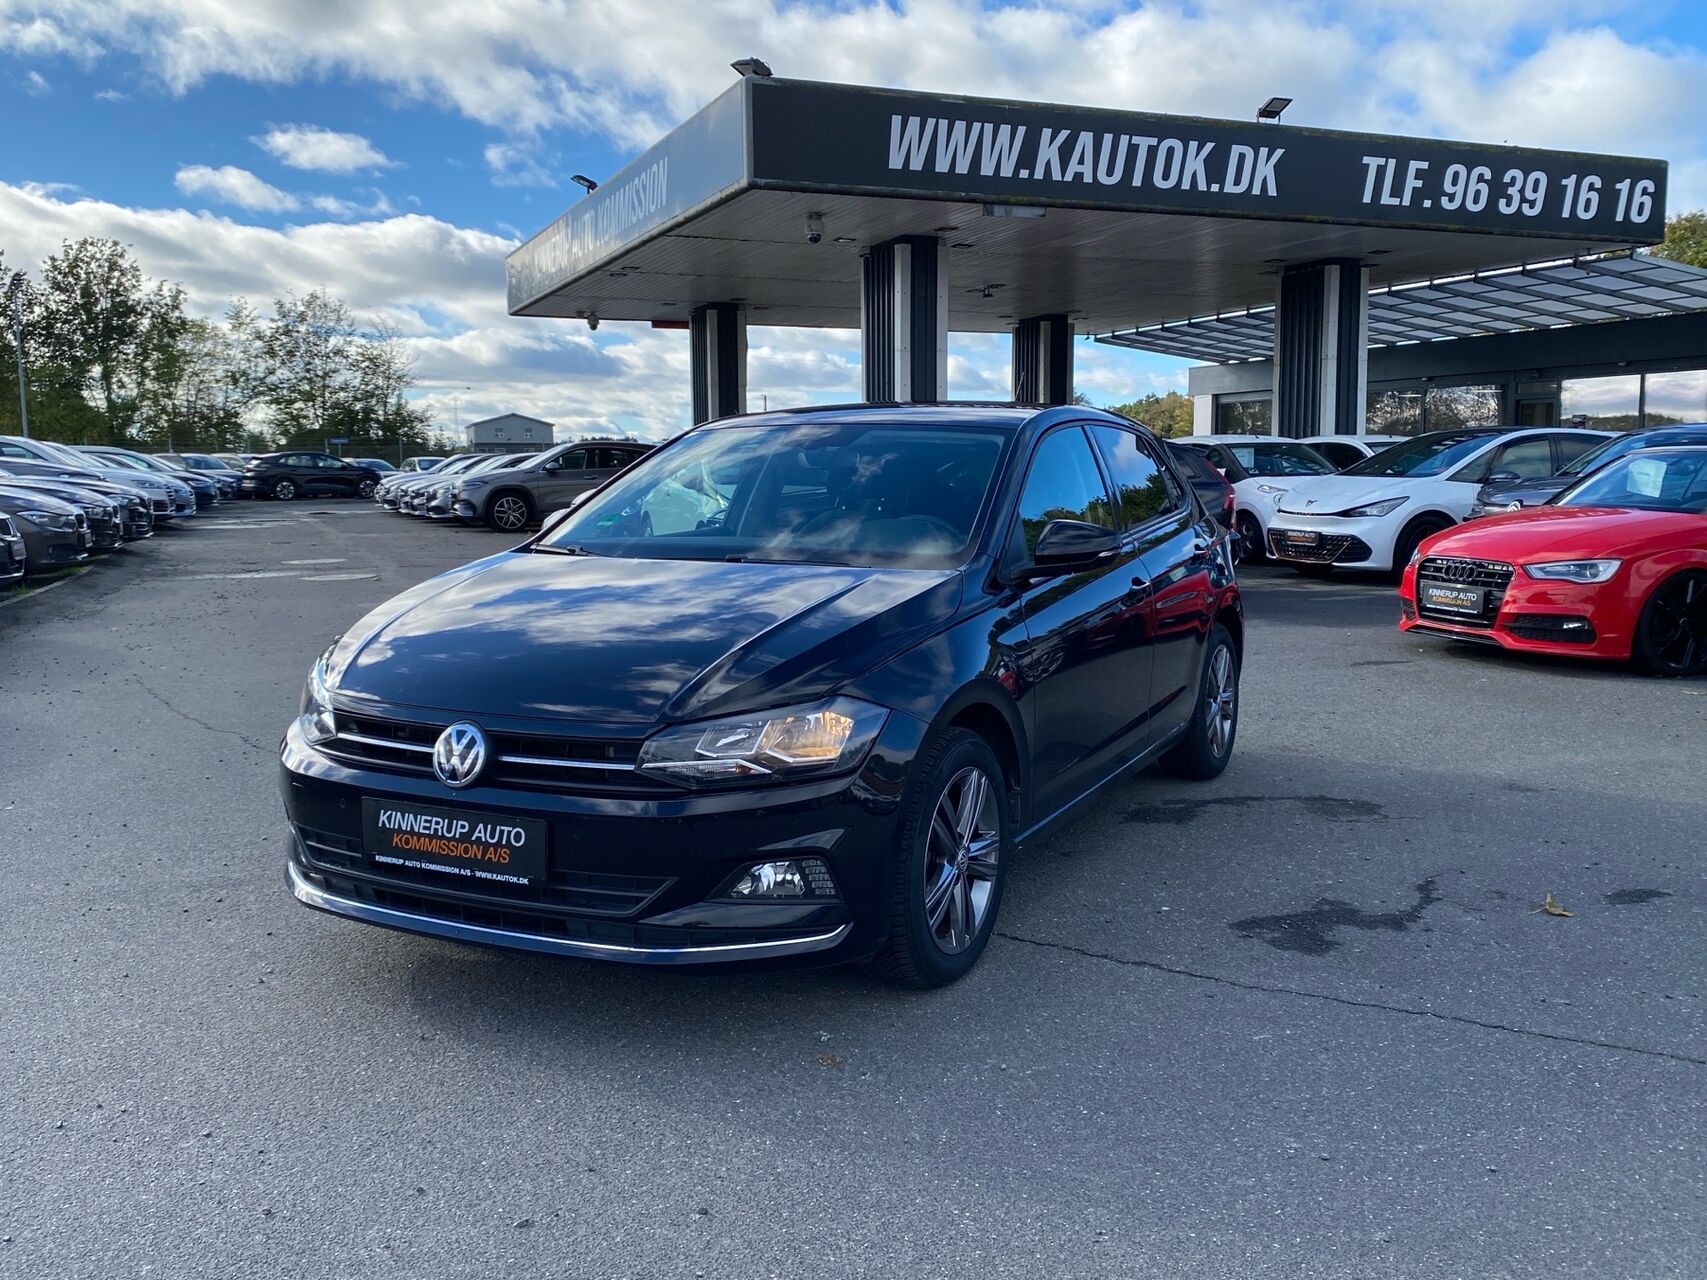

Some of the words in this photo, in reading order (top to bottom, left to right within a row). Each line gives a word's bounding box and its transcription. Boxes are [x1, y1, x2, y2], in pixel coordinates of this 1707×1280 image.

[888, 115, 1285, 197] WWW.KAUTOK.DK
[597, 156, 668, 246] KOMMISSION
[1361, 156, 1432, 208] TLF.
[1440, 163, 1492, 212] 96
[1498, 168, 1548, 217] 39
[1561, 173, 1602, 221] 16
[1615, 178, 1656, 224] 16
[1459, 592, 1477, 601] AUTO
[378, 809, 469, 839] KINNERUP
[471, 823, 526, 847] AUTO
[392, 833, 482, 860] KOMMISSION
[485, 847, 510, 864] A/S
[375, 854, 404, 865] KINNERUP
[404, 860, 421, 869] AUTO
[421, 861, 460, 875] KOMMISSION
[459, 868, 471, 877] A/S
[475, 870, 529, 885] WWW.KAUTOK.DK
